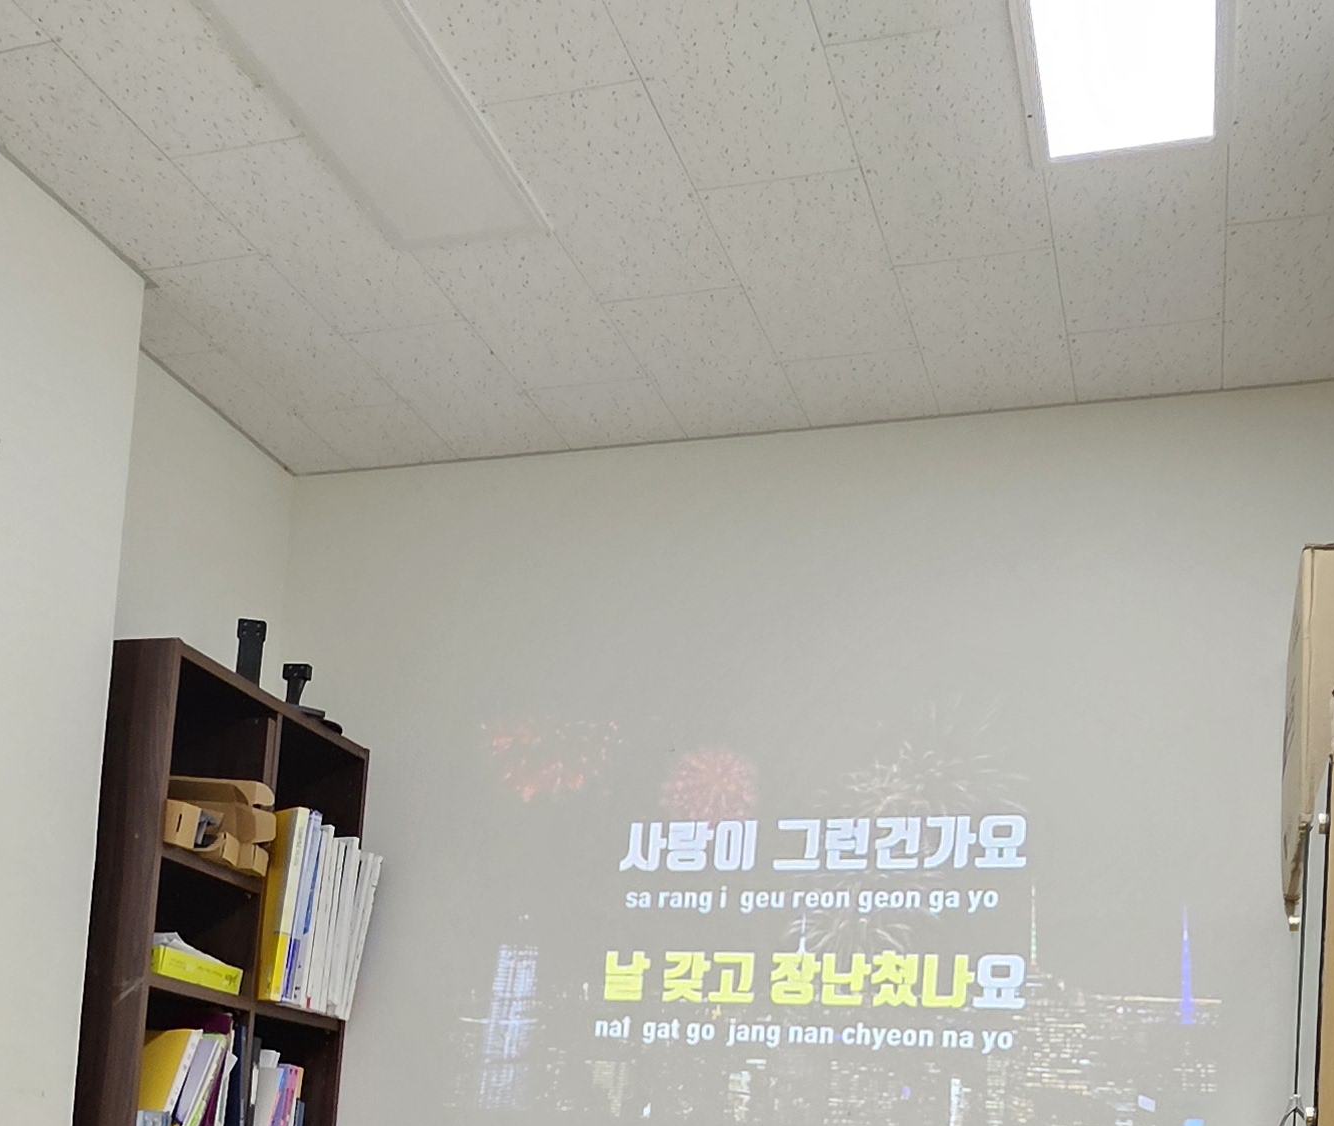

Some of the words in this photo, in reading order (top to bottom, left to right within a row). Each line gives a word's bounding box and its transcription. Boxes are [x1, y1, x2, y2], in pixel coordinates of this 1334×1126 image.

[619, 819, 758, 872] 사랑이
[772, 814, 1027, 872] 그런건가요
[625, 890, 652, 909] sa
[657, 890, 713, 915] rang
[719, 885, 728, 909] i
[739, 890, 785, 915] geu
[791, 890, 851, 909] reon
[857, 889, 922, 914] geon
[928, 889, 961, 914] ga
[967, 889, 999, 914] yo
[603, 950, 651, 1003] 날
[661, 951, 756, 1004] 갖고
[769, 950, 1027, 1010] 장난쳤나요
[642, 1017, 681, 1045] gat
[686, 1022, 716, 1046] go
[725, 1017, 781, 1049] jang
[788, 1024, 834, 1045] nan
[841, 1021, 934, 1051] chyeon
[941, 1028, 974, 1049] na
[981, 1029, 1014, 1055] yo
